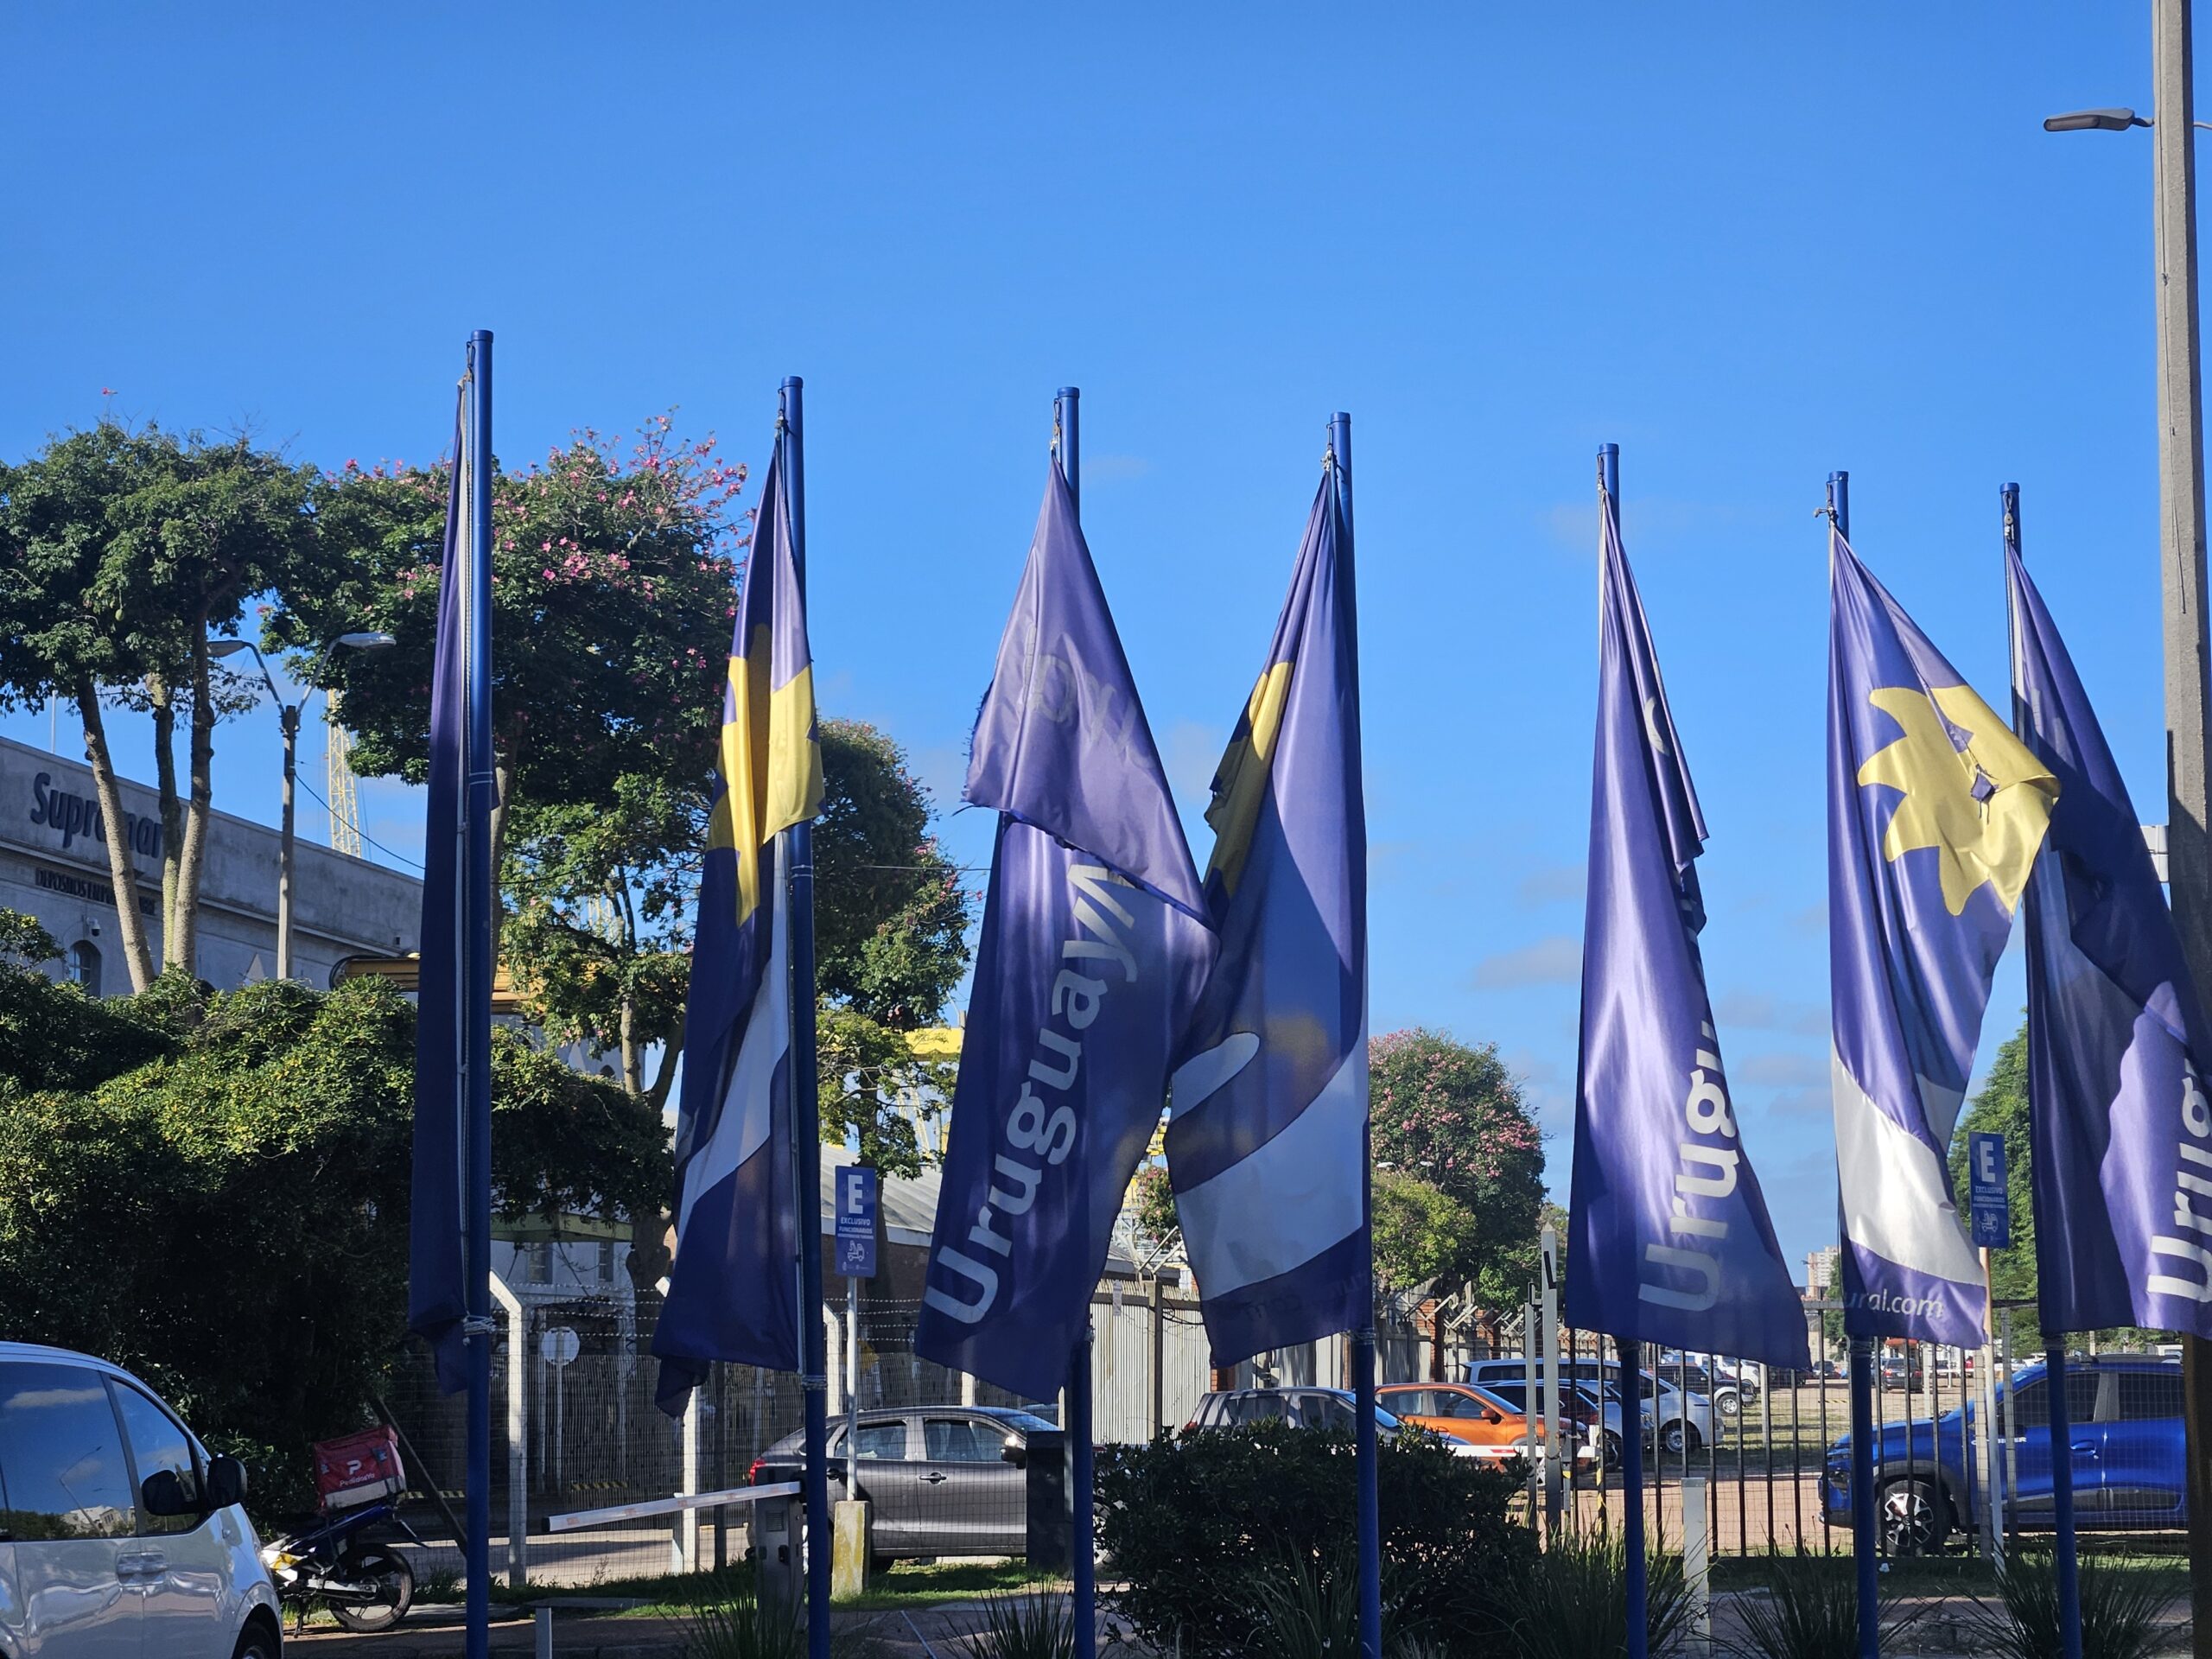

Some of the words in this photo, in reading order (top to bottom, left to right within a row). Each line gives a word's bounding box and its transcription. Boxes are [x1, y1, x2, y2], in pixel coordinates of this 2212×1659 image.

[1980, 1141, 1995, 1182] E
[848, 1174, 863, 1214] E
[841, 1217, 871, 1226] EXCLUSIVO
[340, 1472, 375, 1486] PedidosYa
